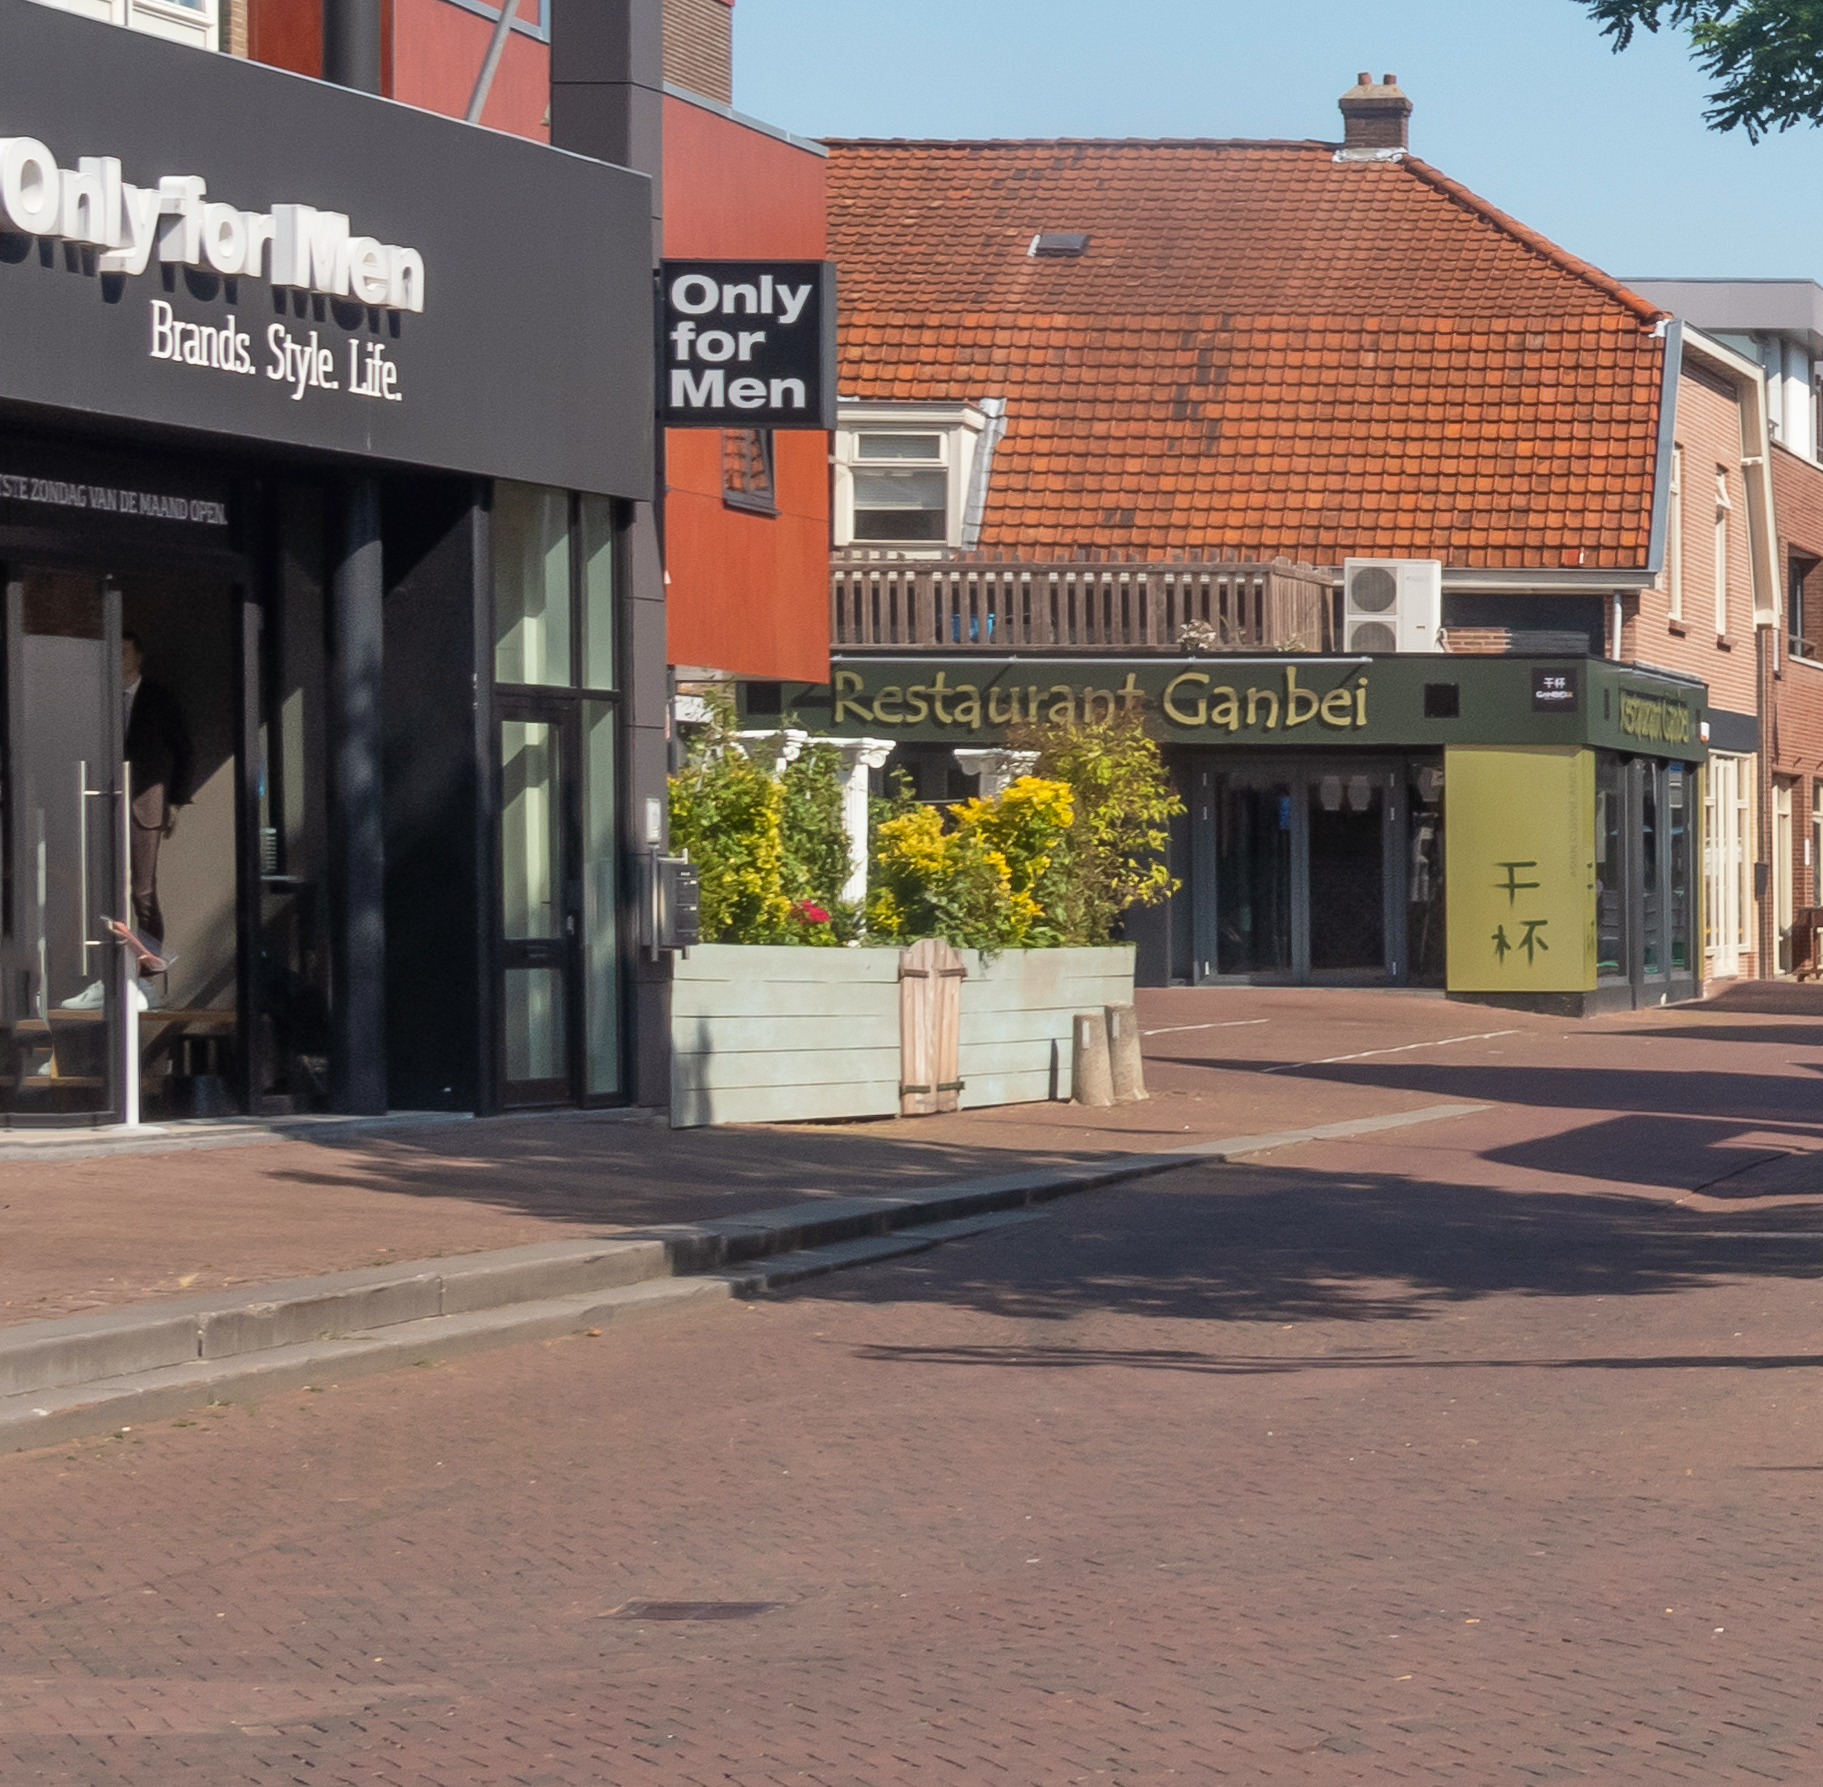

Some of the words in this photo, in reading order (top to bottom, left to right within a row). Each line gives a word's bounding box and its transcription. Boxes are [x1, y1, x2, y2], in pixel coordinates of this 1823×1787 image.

[0, 136, 160, 276] Only
[158, 175, 276, 277] for
[270, 204, 425, 313] Men
[671, 274, 813, 324] Only
[150, 299, 256, 375] Brands.
[266, 323, 339, 401] Style.
[348, 338, 402, 401] Life.
[670, 321, 766, 362] for
[670, 368, 806, 408] Men
[0, 473, 29, 499] STE
[29, 478, 87, 507] ZONDAG
[87, 486, 118, 511] VAN
[119, 490, 138, 513] DE
[138, 492, 188, 520] MAAND
[834, 670, 1146, 729] Restaurant
[1163, 665, 1369, 731] Ganbei
